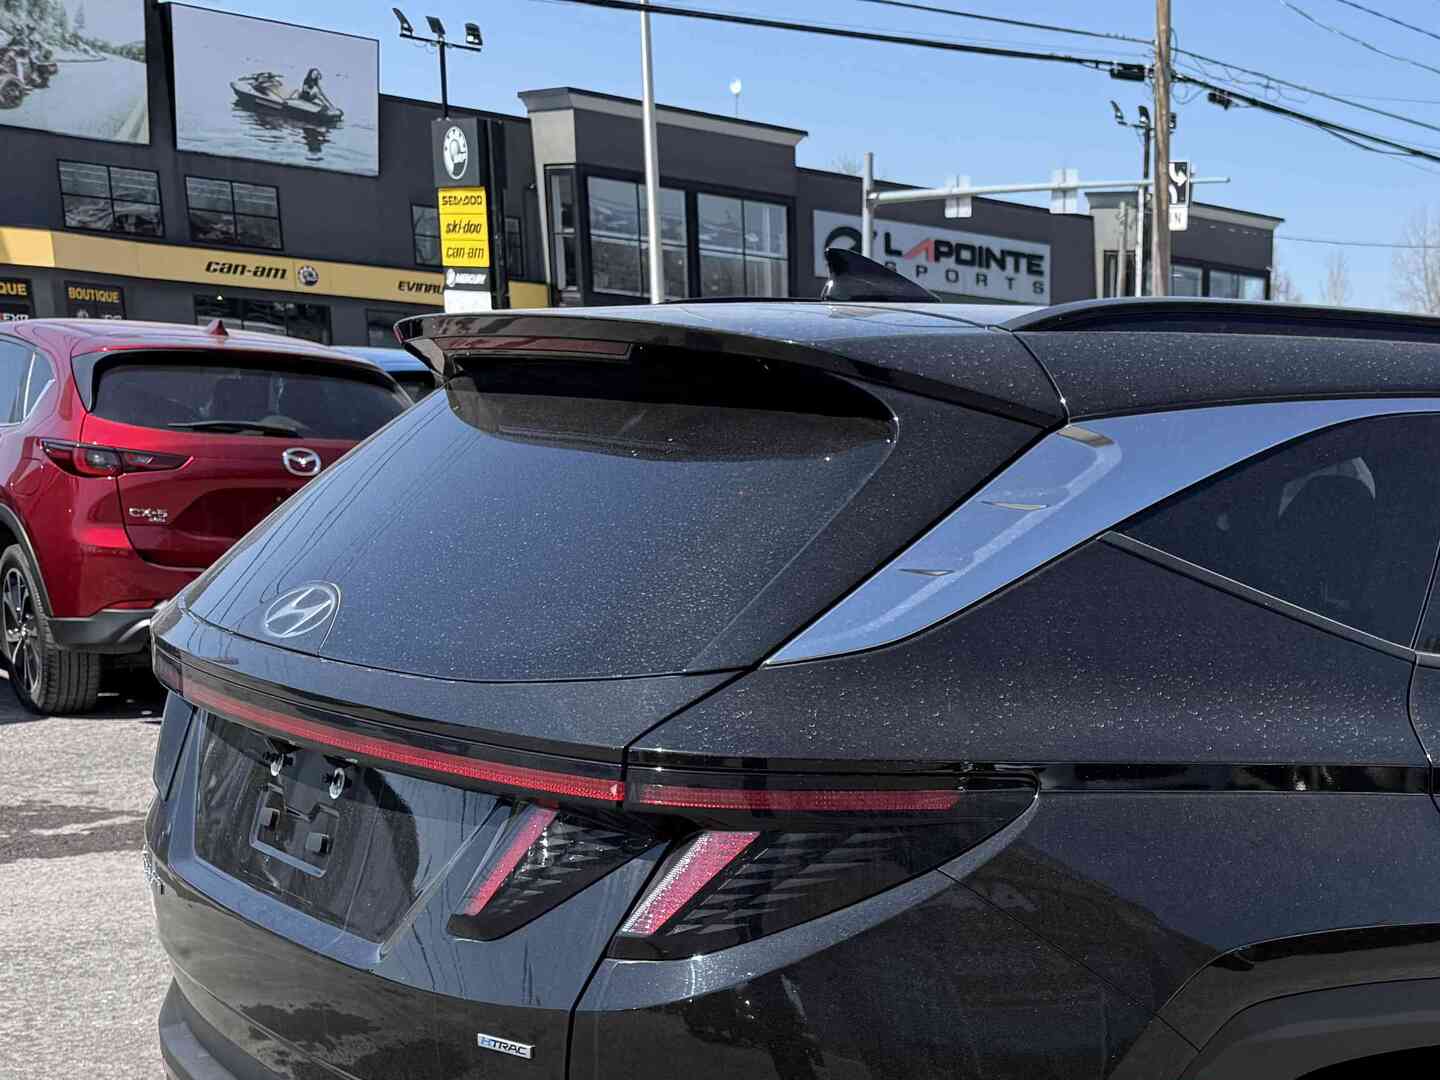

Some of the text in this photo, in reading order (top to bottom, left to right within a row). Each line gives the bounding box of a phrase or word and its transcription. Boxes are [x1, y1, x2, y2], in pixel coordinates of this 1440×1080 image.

[884, 232, 1045, 277] LAPOINTE
[205, 260, 288, 280] can-am
[68, 287, 120, 303] BOUTIQUE
[480, 1036, 528, 1056] HTRAC
